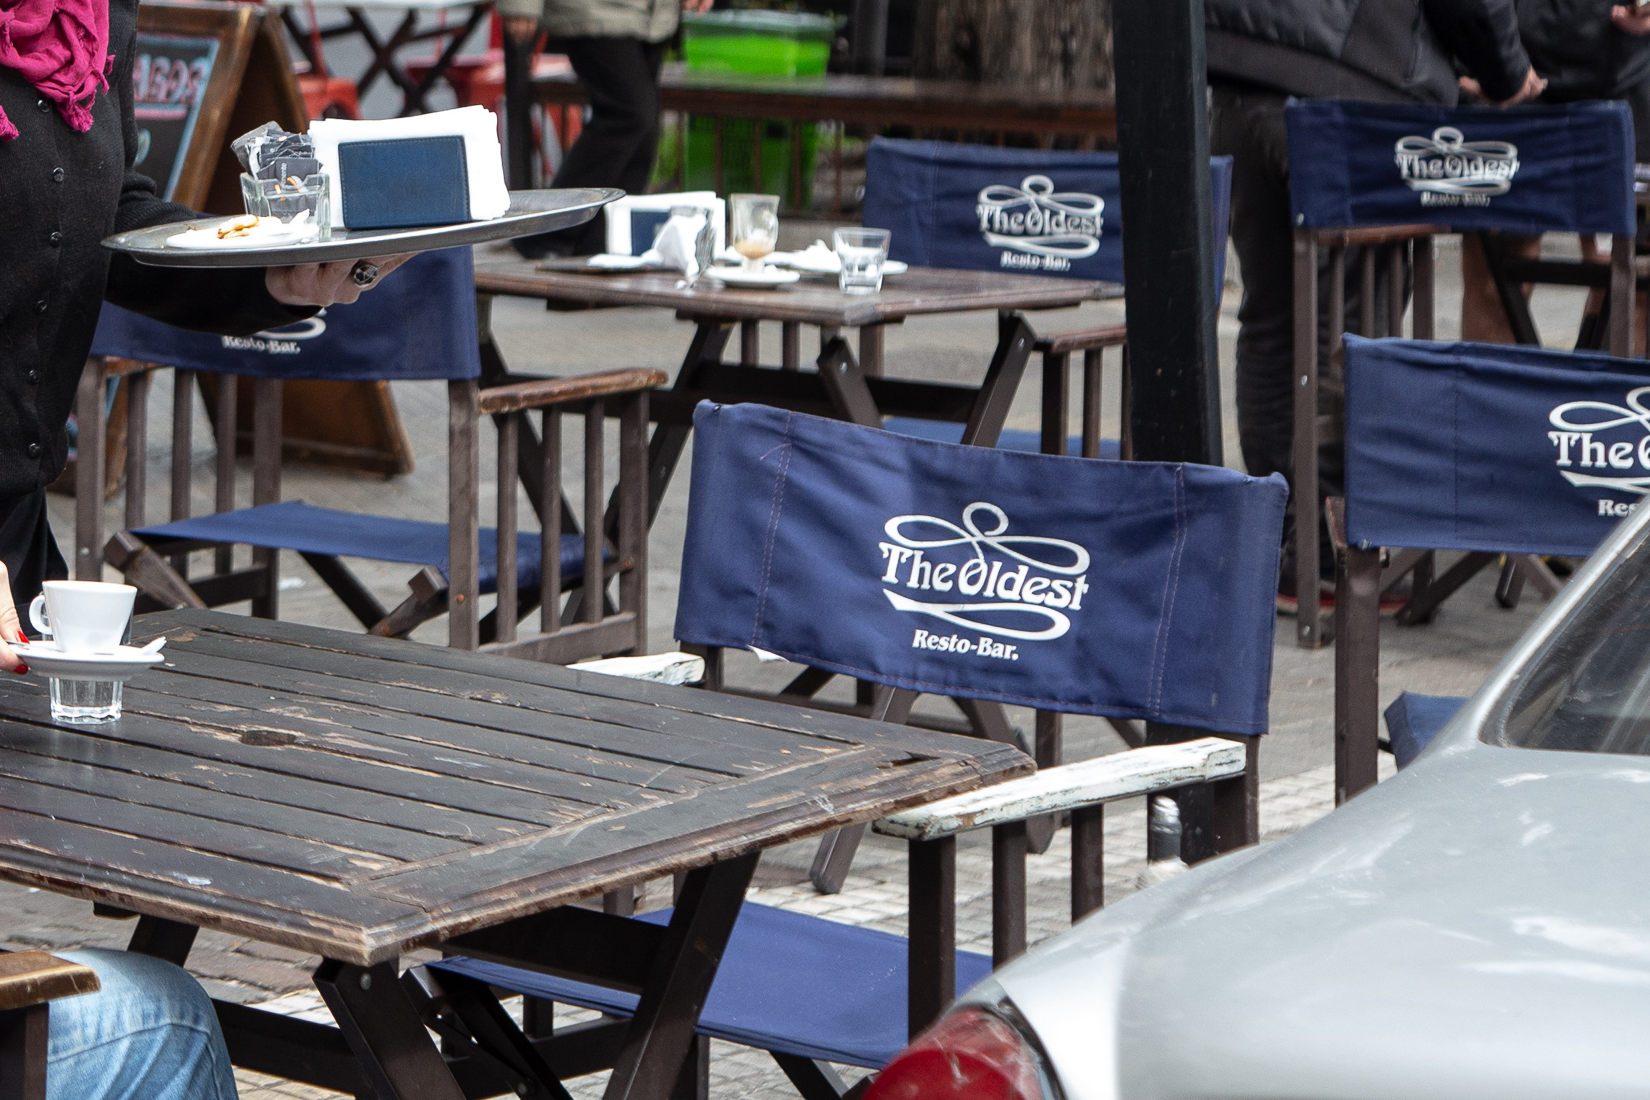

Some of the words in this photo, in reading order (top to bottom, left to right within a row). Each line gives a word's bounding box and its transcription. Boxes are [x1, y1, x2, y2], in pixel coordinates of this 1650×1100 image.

[1394, 154, 1444, 179] The
[1444, 155, 1520, 180] Oldest
[975, 204, 1024, 234] The
[1025, 208, 1104, 238] Oldest
[221, 336, 301, 355] Resto-Bar.
[1548, 431, 1634, 469] The
[878, 542, 957, 592] The
[958, 557, 1089, 611] Oldest
[912, 629, 1019, 661] Resto-Bar.
